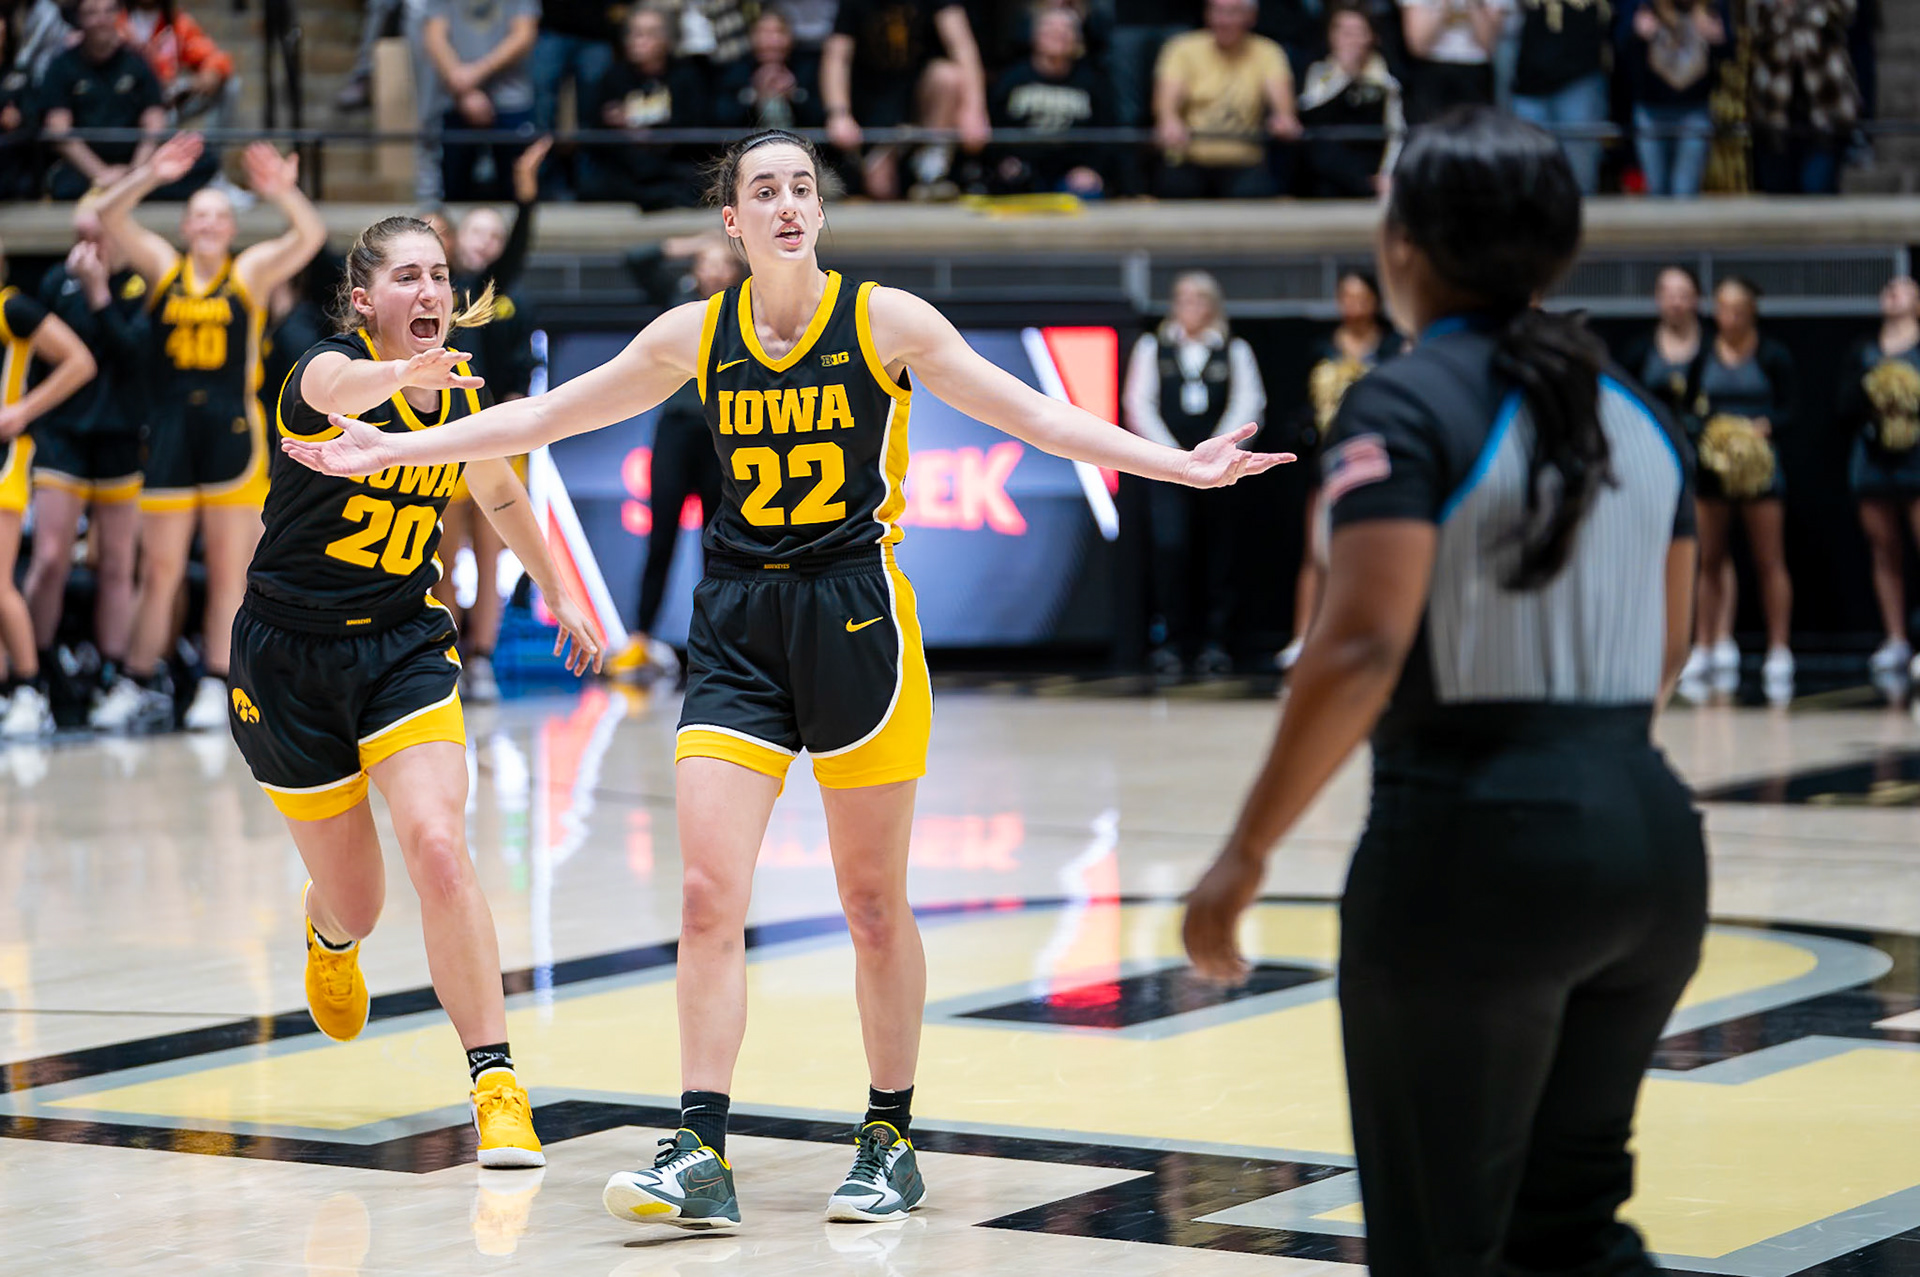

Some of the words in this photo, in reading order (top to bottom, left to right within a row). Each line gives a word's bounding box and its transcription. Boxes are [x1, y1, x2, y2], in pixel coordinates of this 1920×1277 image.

[718, 383, 855, 435] IOWA
[348, 462, 460, 498] OWA
[730, 441, 846, 527] 22
[324, 493, 438, 576] 20
